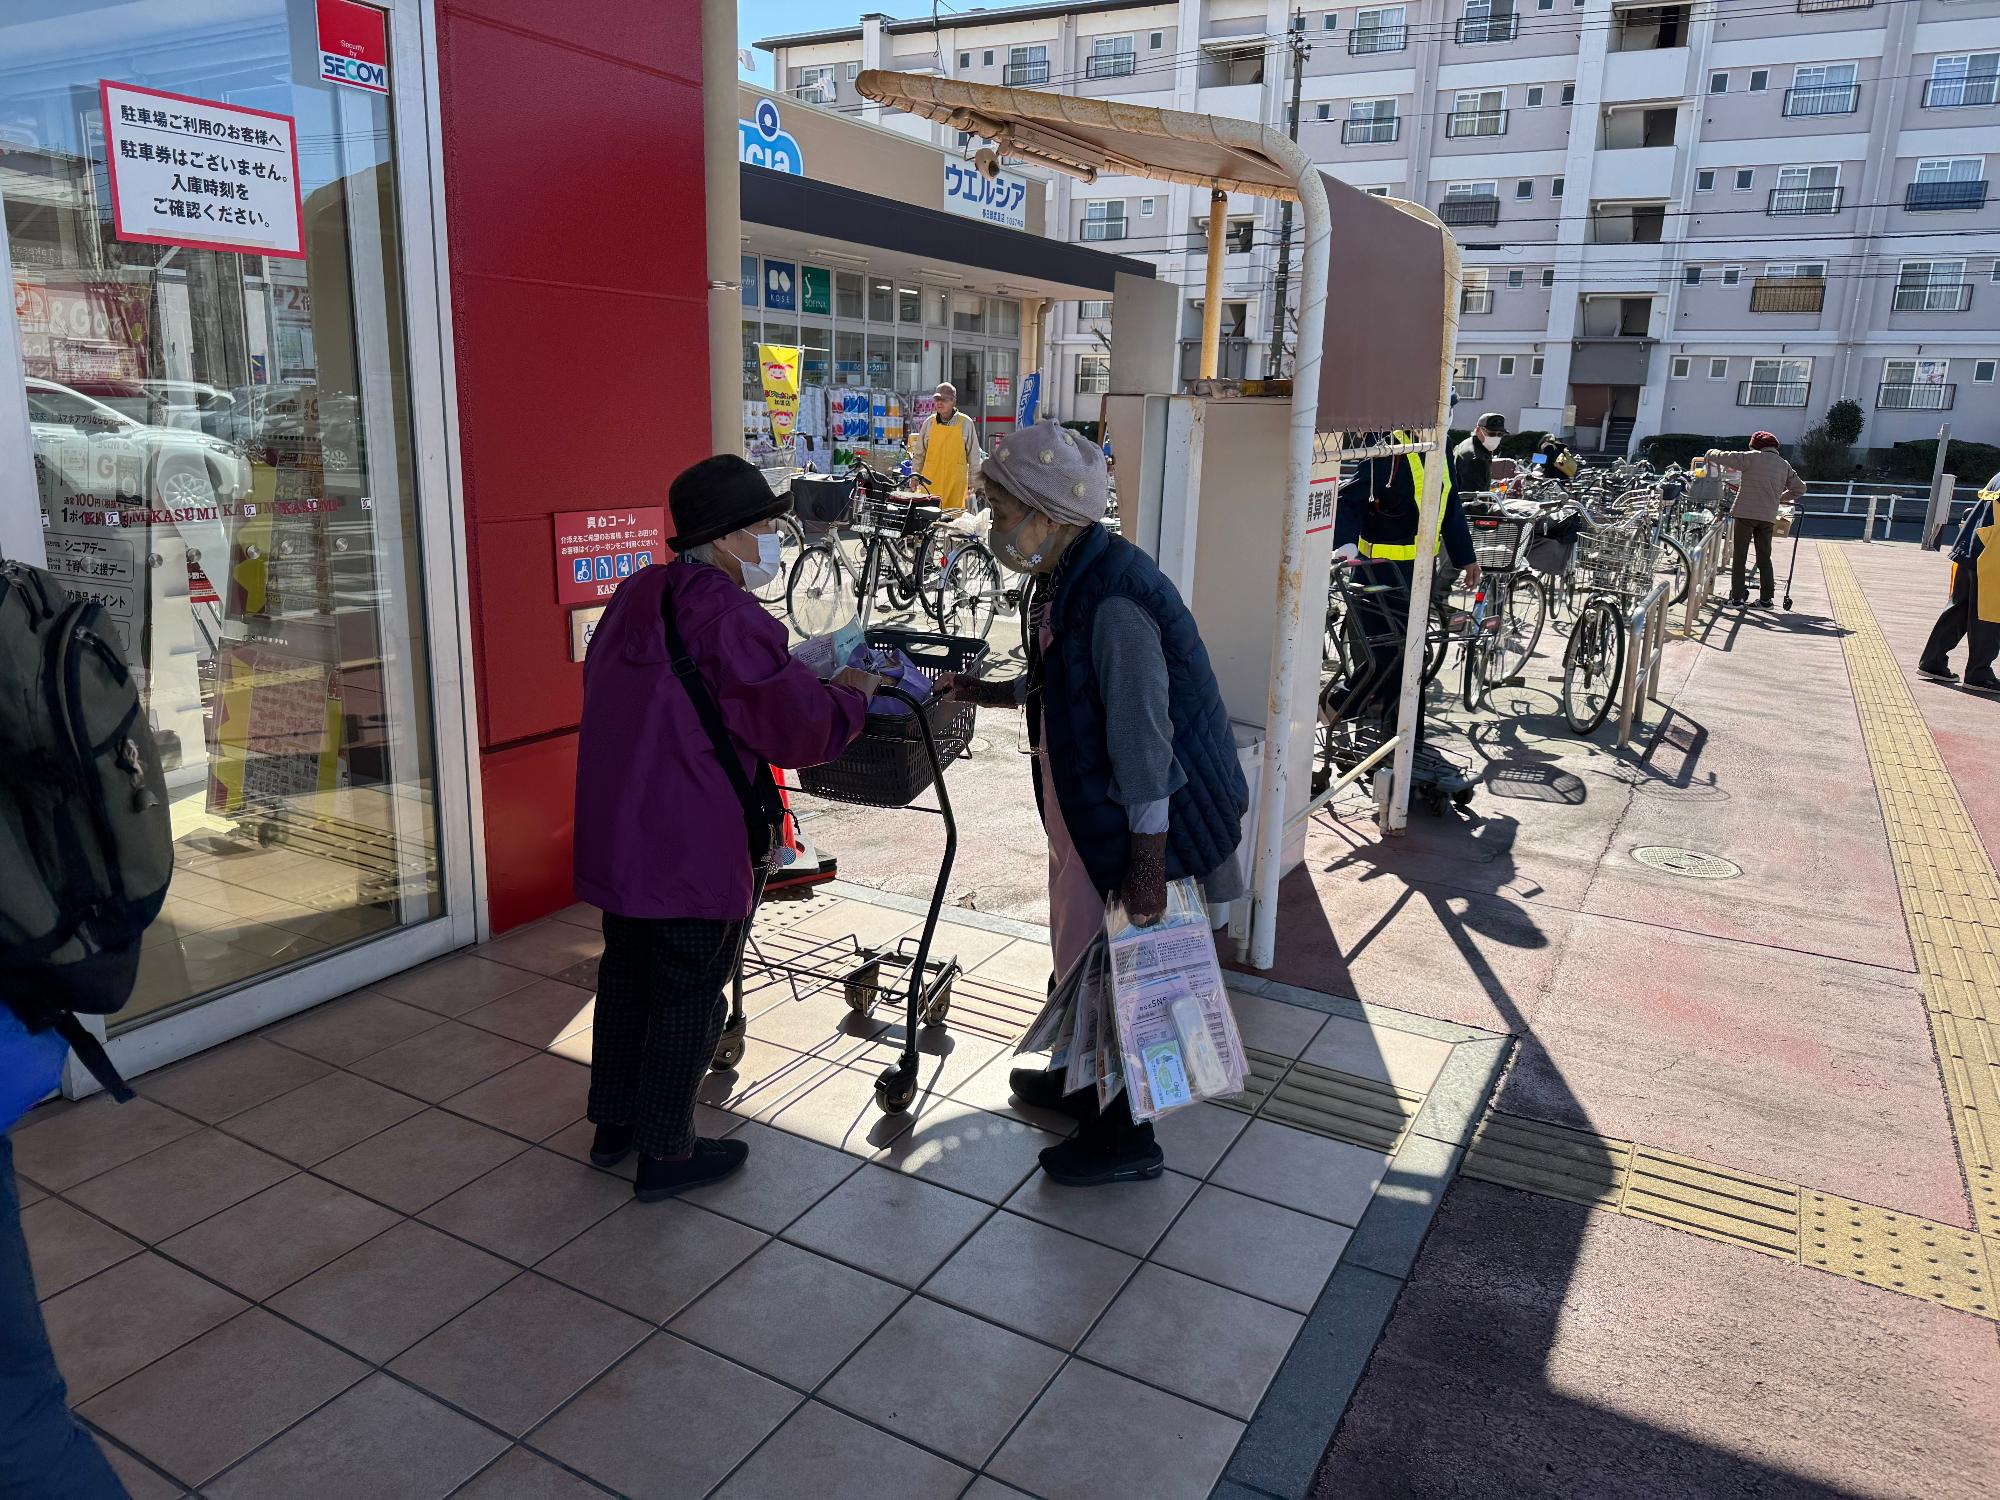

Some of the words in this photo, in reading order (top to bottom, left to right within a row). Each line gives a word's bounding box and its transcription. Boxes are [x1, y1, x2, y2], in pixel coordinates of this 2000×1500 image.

[341, 40, 365, 53] Security
[349, 49, 357, 58] by
[323, 54, 385, 86] SECOM
[120, 104, 283, 147] 駐車場ご利用のお客様へ
[120, 139, 289, 183] 駐車券はございません。
[170, 173, 250, 201] 入庫時刻を
[944, 163, 1025, 211] ウエルシア
[153, 197, 271, 228] ご確認ください。
[151, 506, 219, 524] KASUMI
[586, 513, 637, 529] 真心コール
[64, 539, 107, 554] シニアデー
[65, 558, 127, 577] 子育支援デー
